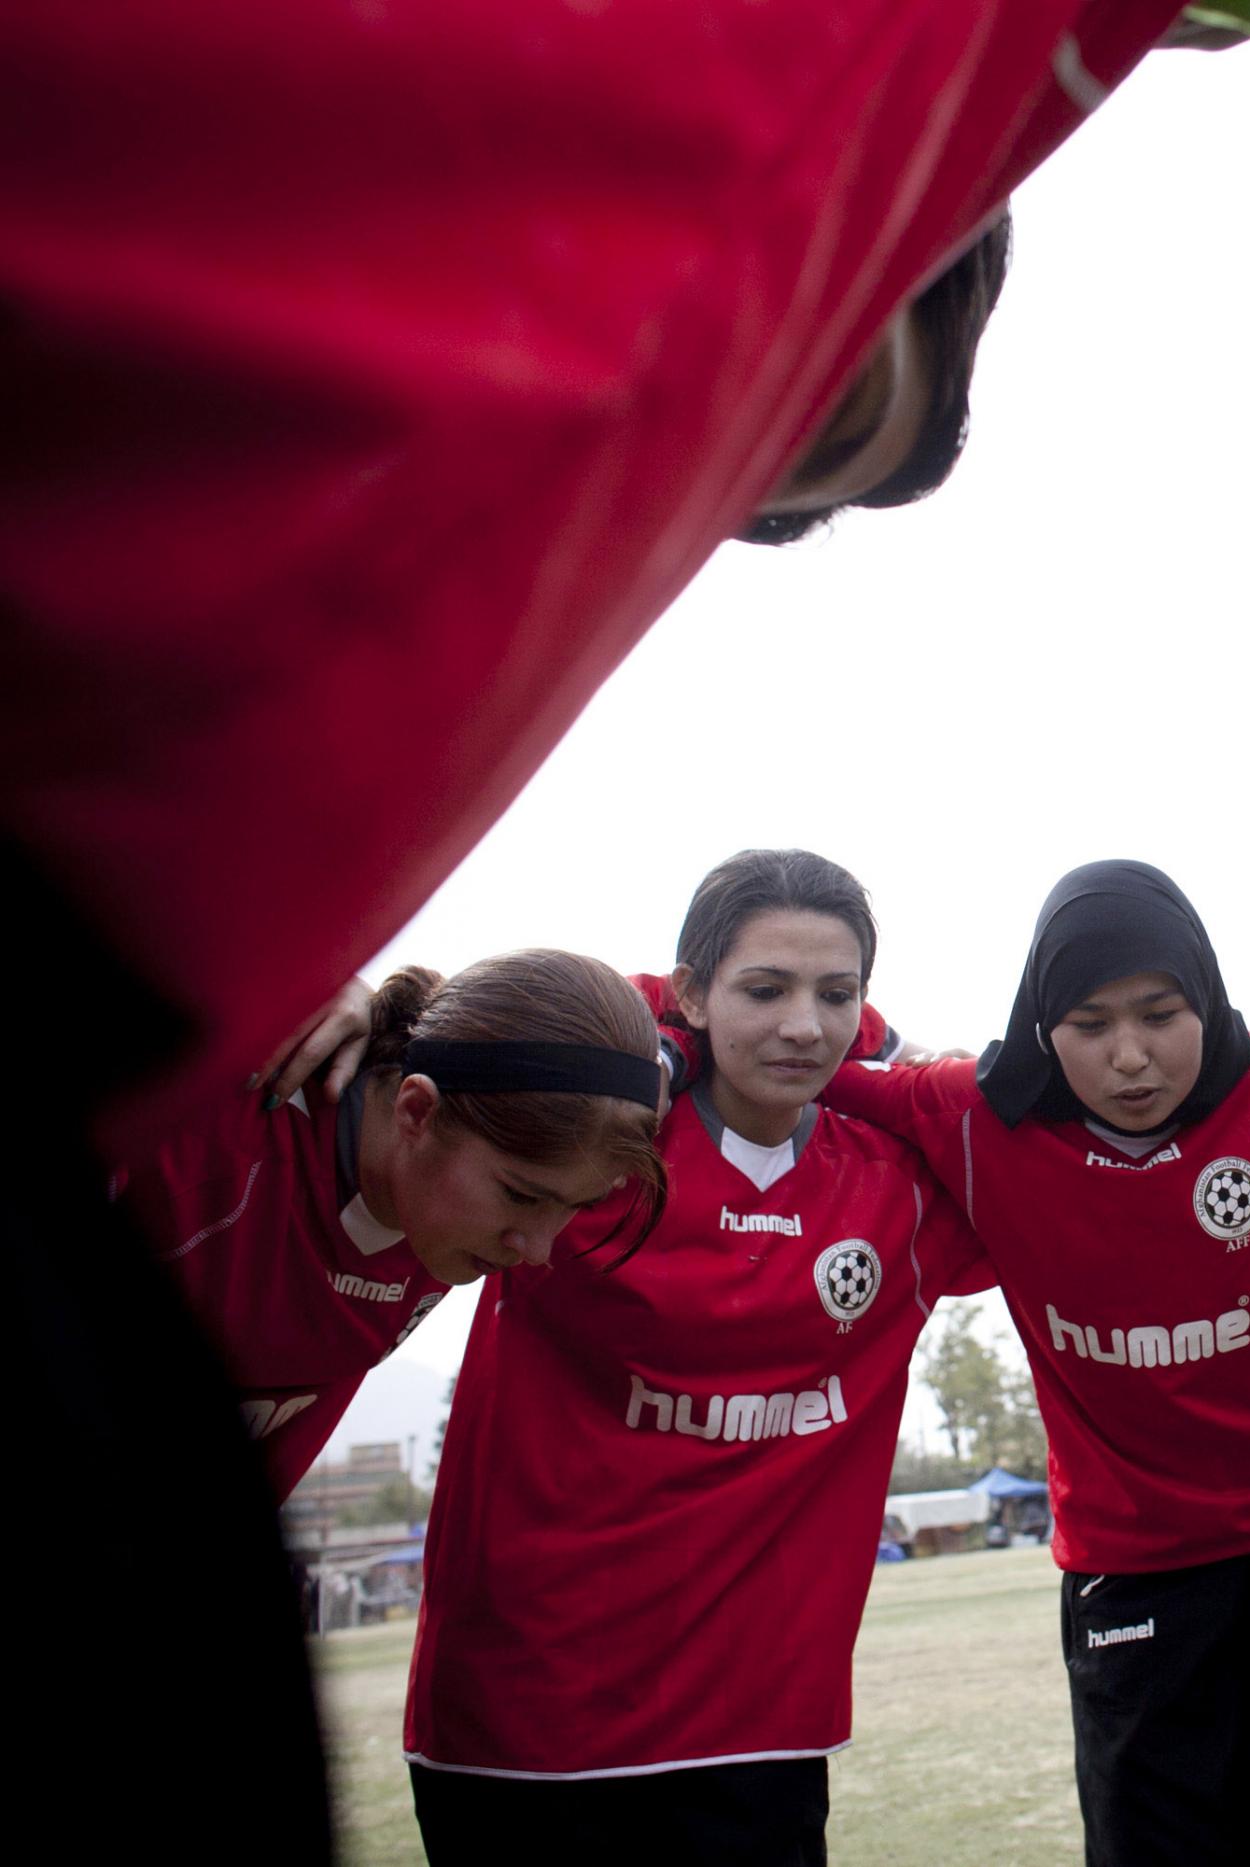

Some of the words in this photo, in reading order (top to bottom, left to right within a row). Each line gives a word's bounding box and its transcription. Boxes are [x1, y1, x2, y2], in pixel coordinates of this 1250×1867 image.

[1086, 1142, 1182, 1171] huel
[720, 1205, 803, 1236] hummel
[1226, 1235, 1250, 1253] AFF
[326, 1269, 411, 1302] ummel
[625, 1374, 848, 1442] hummel
[1088, 1617, 1154, 1649] hummel
